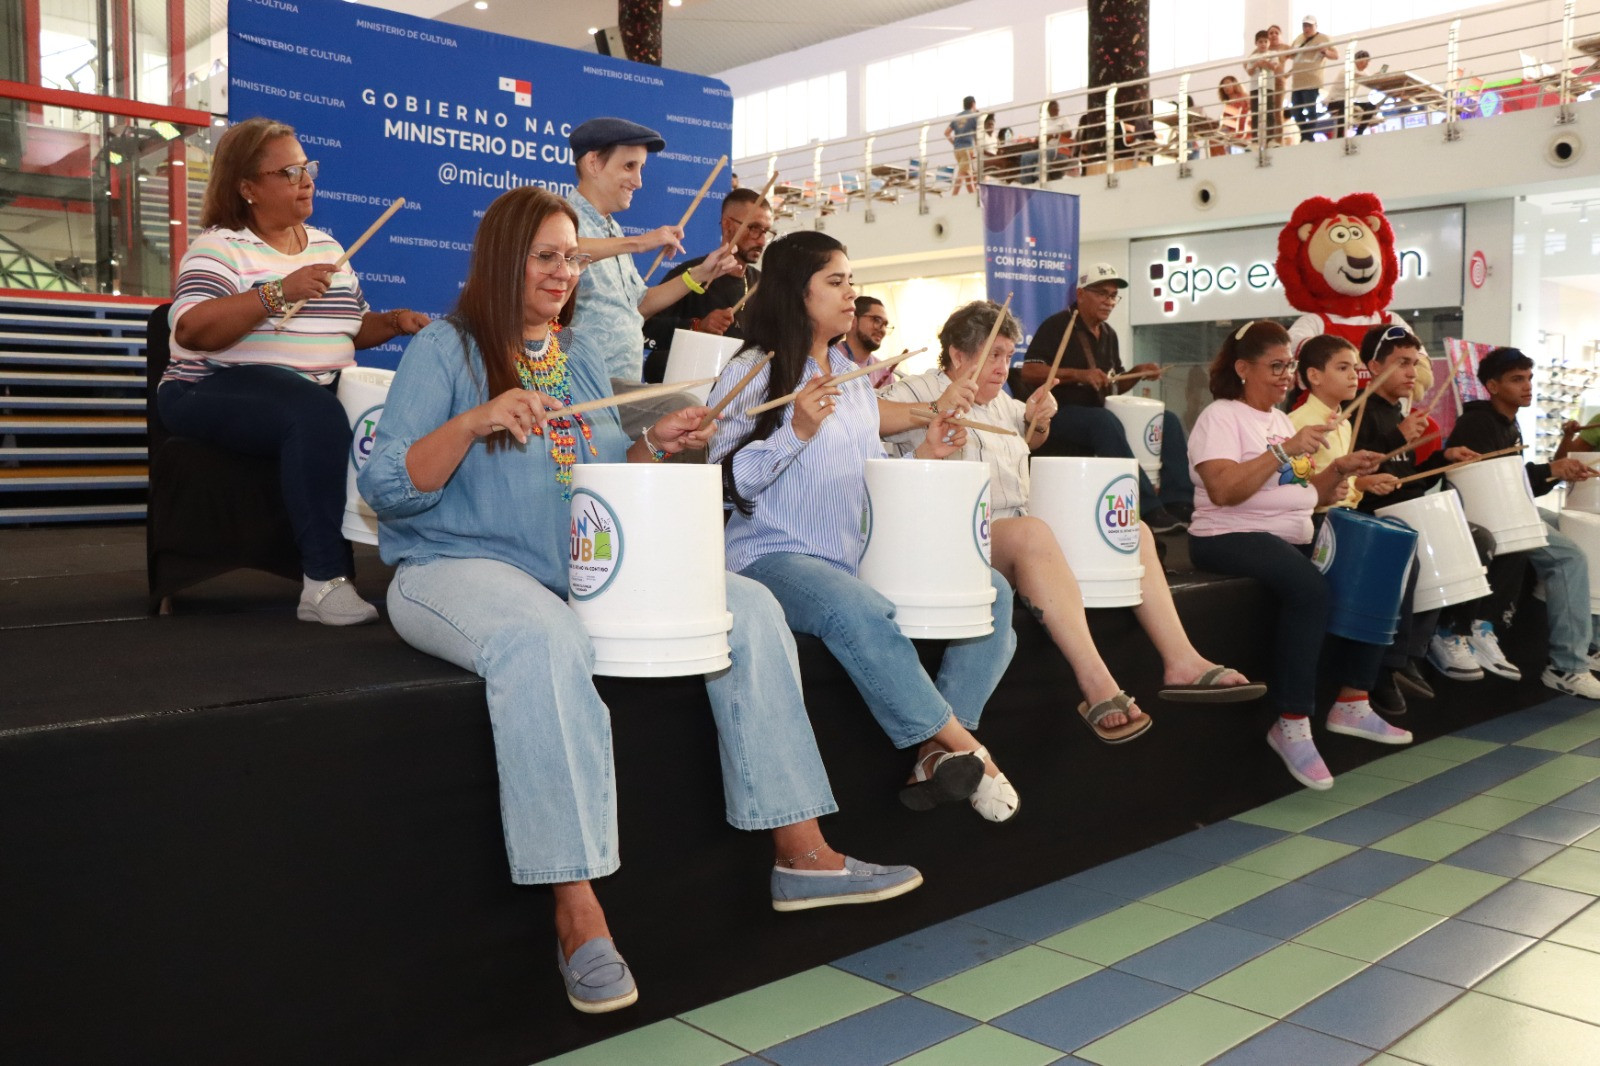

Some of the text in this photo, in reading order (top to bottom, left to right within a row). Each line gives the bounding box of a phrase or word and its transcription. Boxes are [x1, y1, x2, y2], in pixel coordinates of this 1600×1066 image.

[356, 19, 458, 48] MINISTERIO DE CULTURA
[239, 32, 352, 64] MINISTERIO DE CULTURA
[583, 65, 664, 87] MINISTERIO DE CULTURA
[231, 77, 346, 108] MINISTERIO DE CULTURA
[703, 87, 732, 97] MINISTER
[362, 88, 508, 128] GOBIERNO
[666, 114, 733, 130] MINISTERIO DE CULTU
[300, 134, 342, 148] CULTURA
[384, 118, 506, 155] MINISTERIO
[511, 140, 537, 160] DE
[657, 151, 693, 162] MINISTERIO
[702, 157, 728, 167] CULT
[438, 162, 574, 198] @miculturapm
[316, 189, 422, 211] MINISTERIO DE CUURA
[667, 186, 699, 197] MINISTERI
[711, 192, 727, 200] CULT
[390, 235, 473, 251] MINISTERIO DE CULT
[986, 246, 1072, 260] GOBIERNO NACIONAL
[995, 255, 1066, 271] CON PASO FIRME
[366, 273, 406, 284] CULTURA
[994, 271, 1066, 284] MINISTERIO DE CULTURA
[1168, 266, 1237, 302] apc
[1105, 494, 1133, 510] TAN
[570, 515, 588, 538] AN
[1105, 509, 1135, 527] CUB
[569, 537, 593, 562] UB
